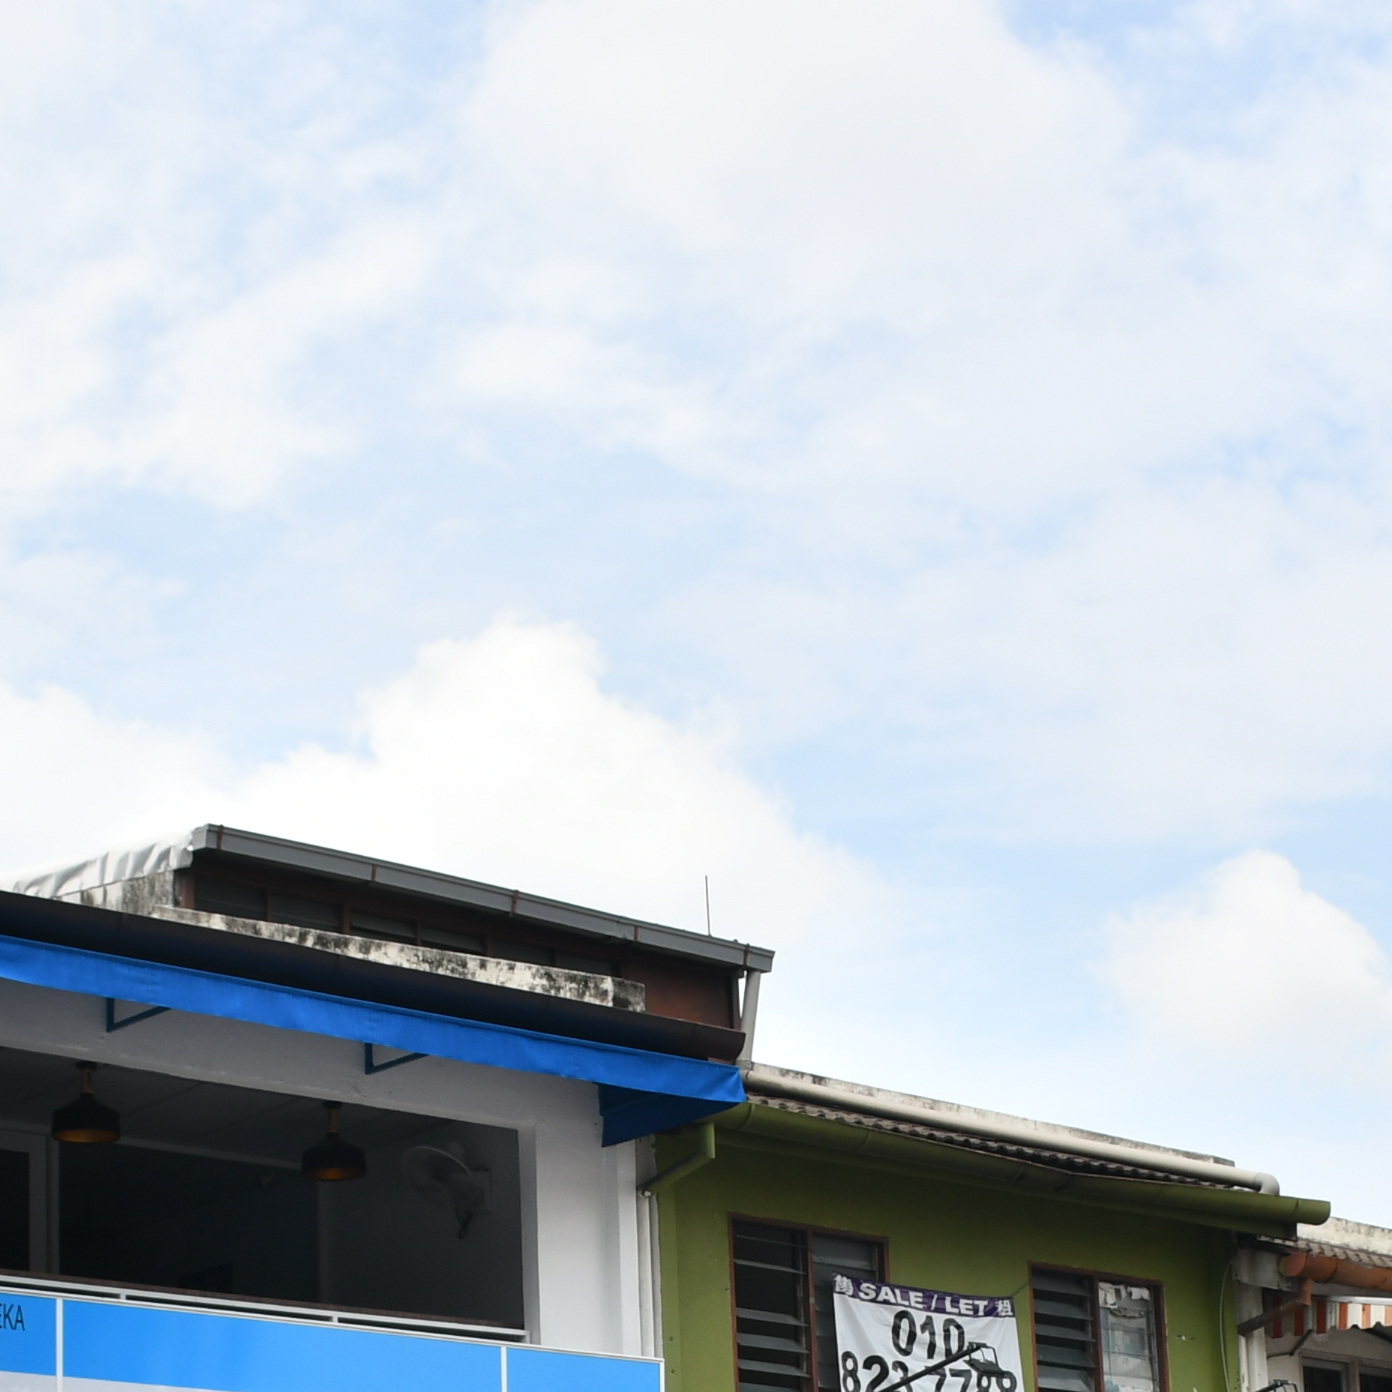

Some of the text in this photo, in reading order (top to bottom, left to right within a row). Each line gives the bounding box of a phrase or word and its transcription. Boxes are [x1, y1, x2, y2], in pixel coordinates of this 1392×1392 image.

[859, 1283, 923, 1308] SALE
[945, 1297, 988, 1316] LET
[892, 1310, 966, 1360] 010
